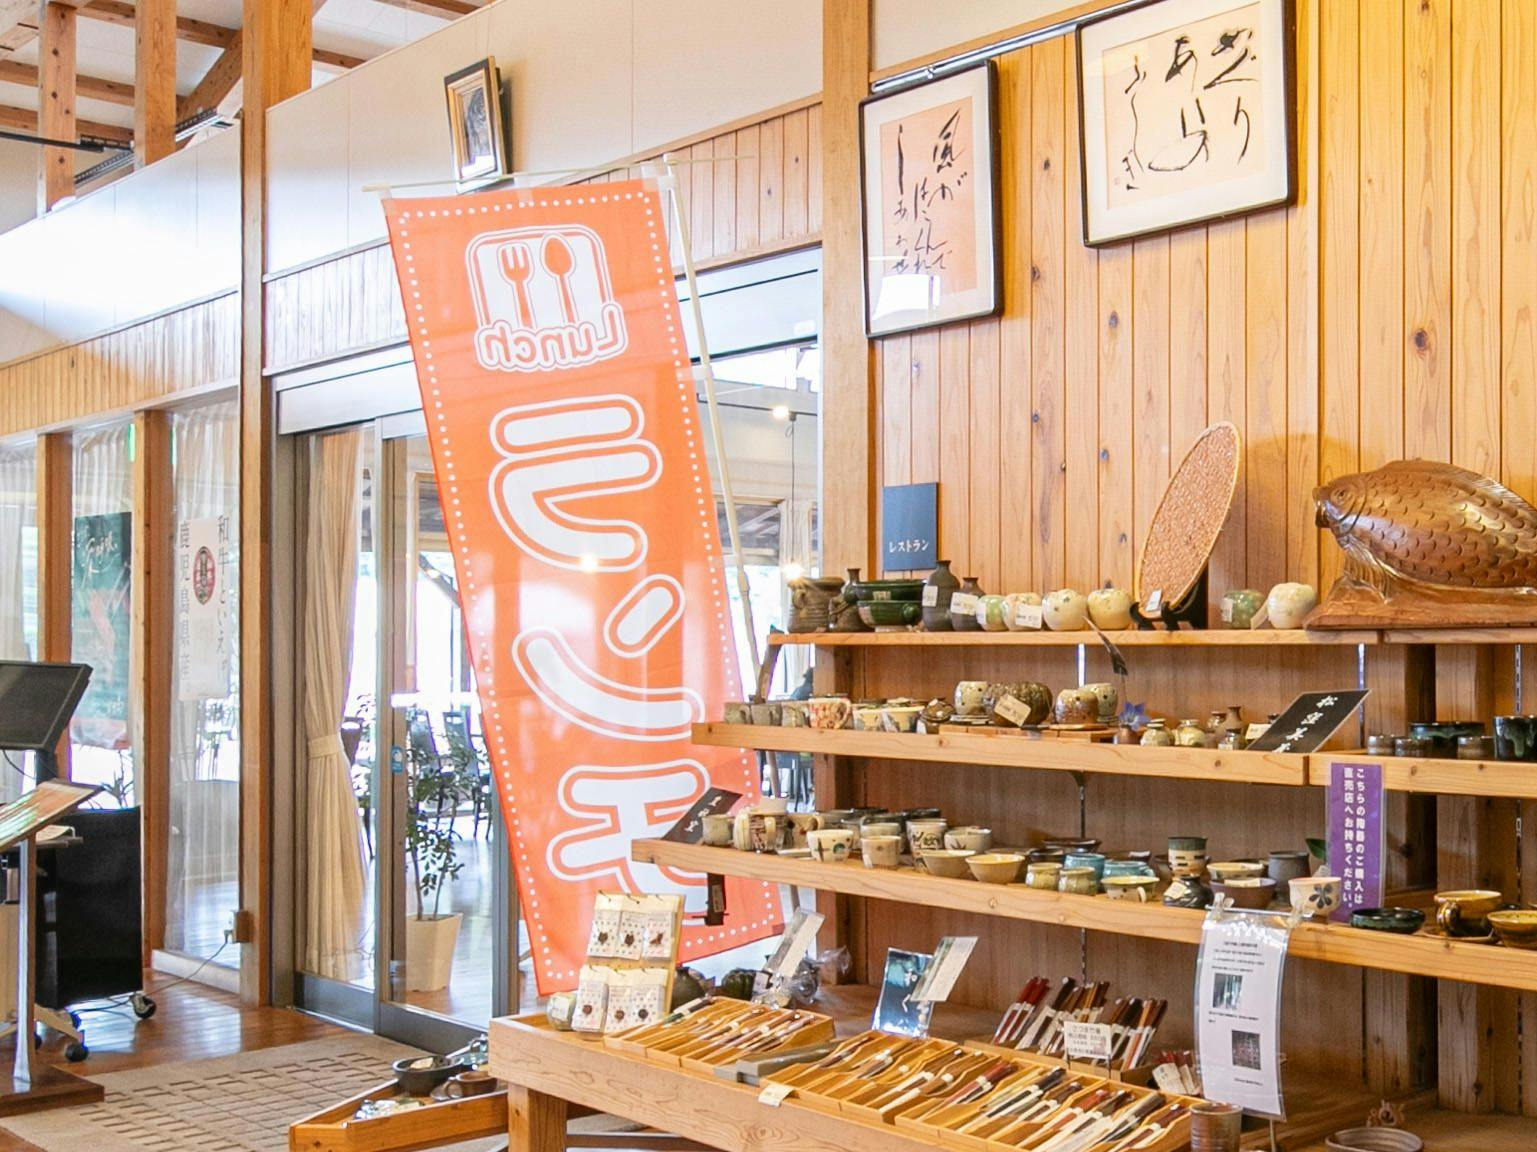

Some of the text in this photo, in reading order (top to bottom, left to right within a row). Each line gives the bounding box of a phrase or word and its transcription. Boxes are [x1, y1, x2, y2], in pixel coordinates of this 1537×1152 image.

[888, 540, 929, 553] レストラン
[1354, 768, 1366, 905] こちらの陶器のご購入は
